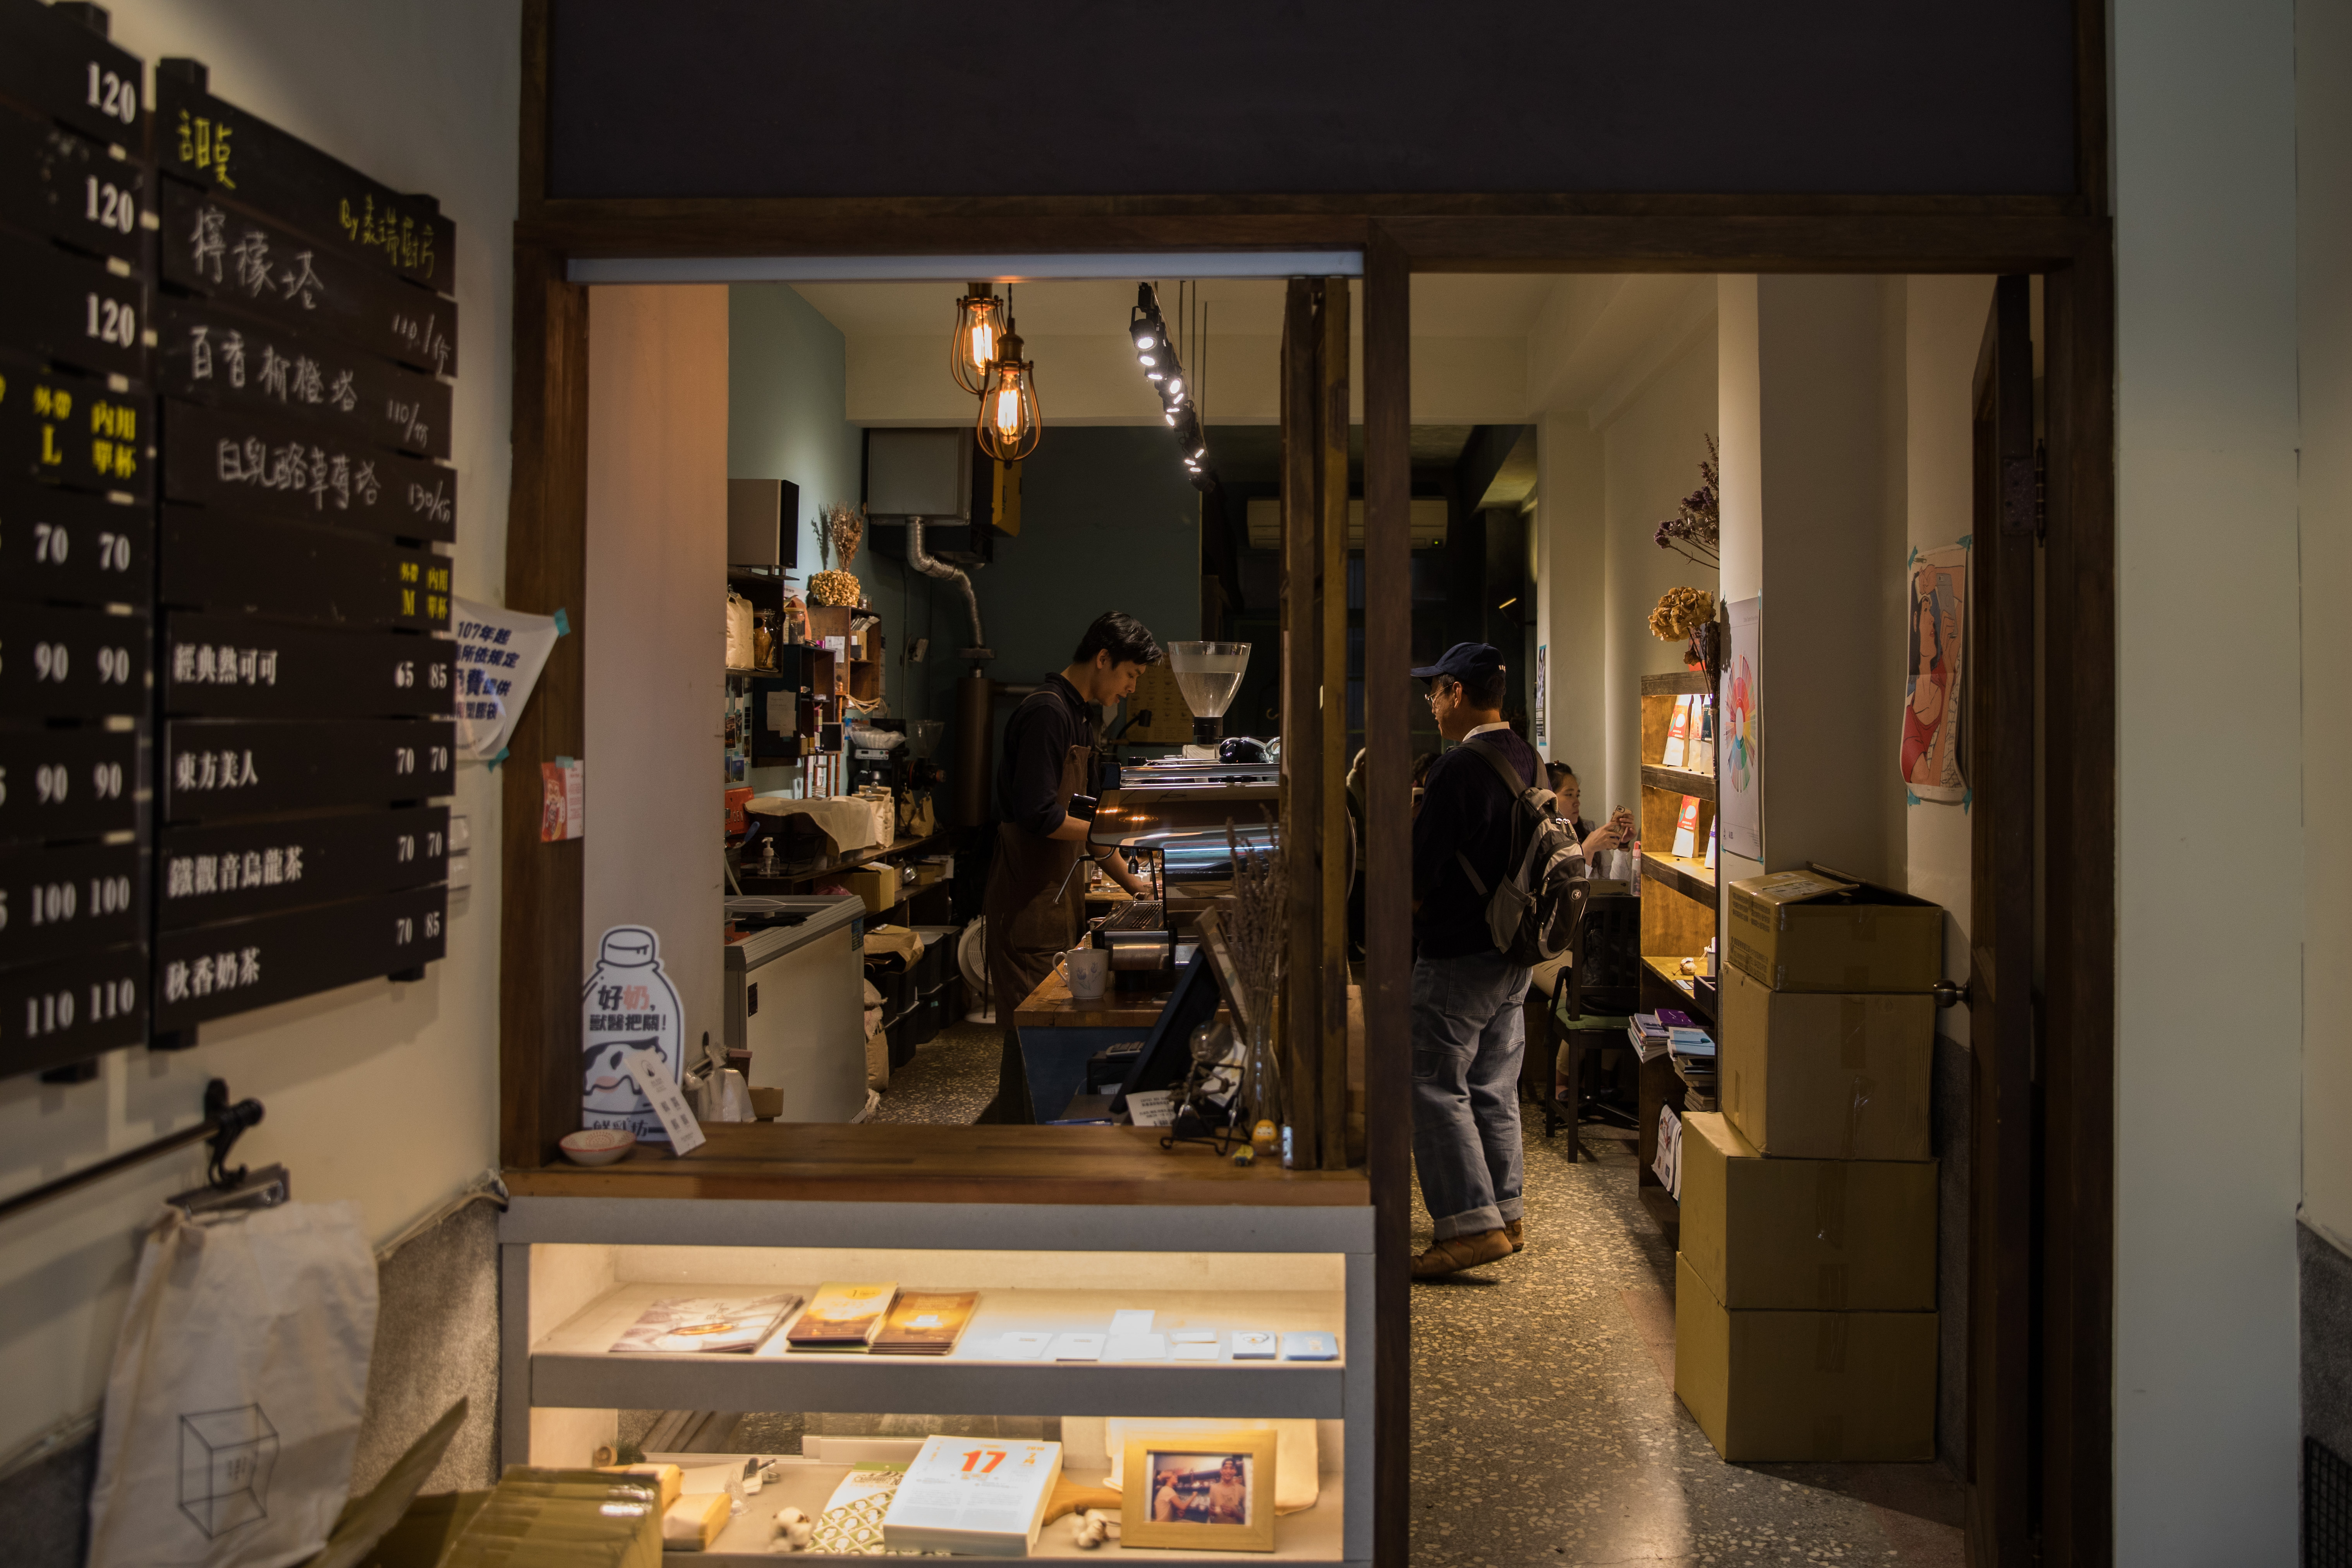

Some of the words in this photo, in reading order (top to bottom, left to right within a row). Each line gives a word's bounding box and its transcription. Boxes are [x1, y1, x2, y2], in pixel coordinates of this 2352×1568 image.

[86, 60, 136, 124] 120
[85, 173, 134, 235] 120
[189, 202, 324, 309] 檸檬塔
[85, 292, 135, 349] 120
[41, 422, 63, 466] L
[33, 521, 69, 566] 70
[98, 531, 131, 573] 70
[401, 587, 416, 617] M
[458, 621, 512, 646] 107年起
[33, 640, 69, 684] 90
[97, 645, 130, 685] 90
[173, 642, 278, 687] 經典熱可可
[394, 661, 415, 689] 65
[428, 663, 448, 690] 85
[35, 763, 69, 805] 90
[93, 761, 122, 800] 90
[174, 749, 259, 792] 東方美人
[396, 747, 415, 775] 70
[430, 745, 448, 773] 70
[397, 835, 415, 863] 70
[427, 831, 443, 858] 70
[31, 880, 77, 927] 100
[89, 874, 130, 918] 100
[396, 917, 413, 946] 70
[424, 911, 441, 939] 85
[26, 989, 75, 1039] 110
[89, 977, 136, 1024] 110
[961, 1450, 1007, 1473] 17
